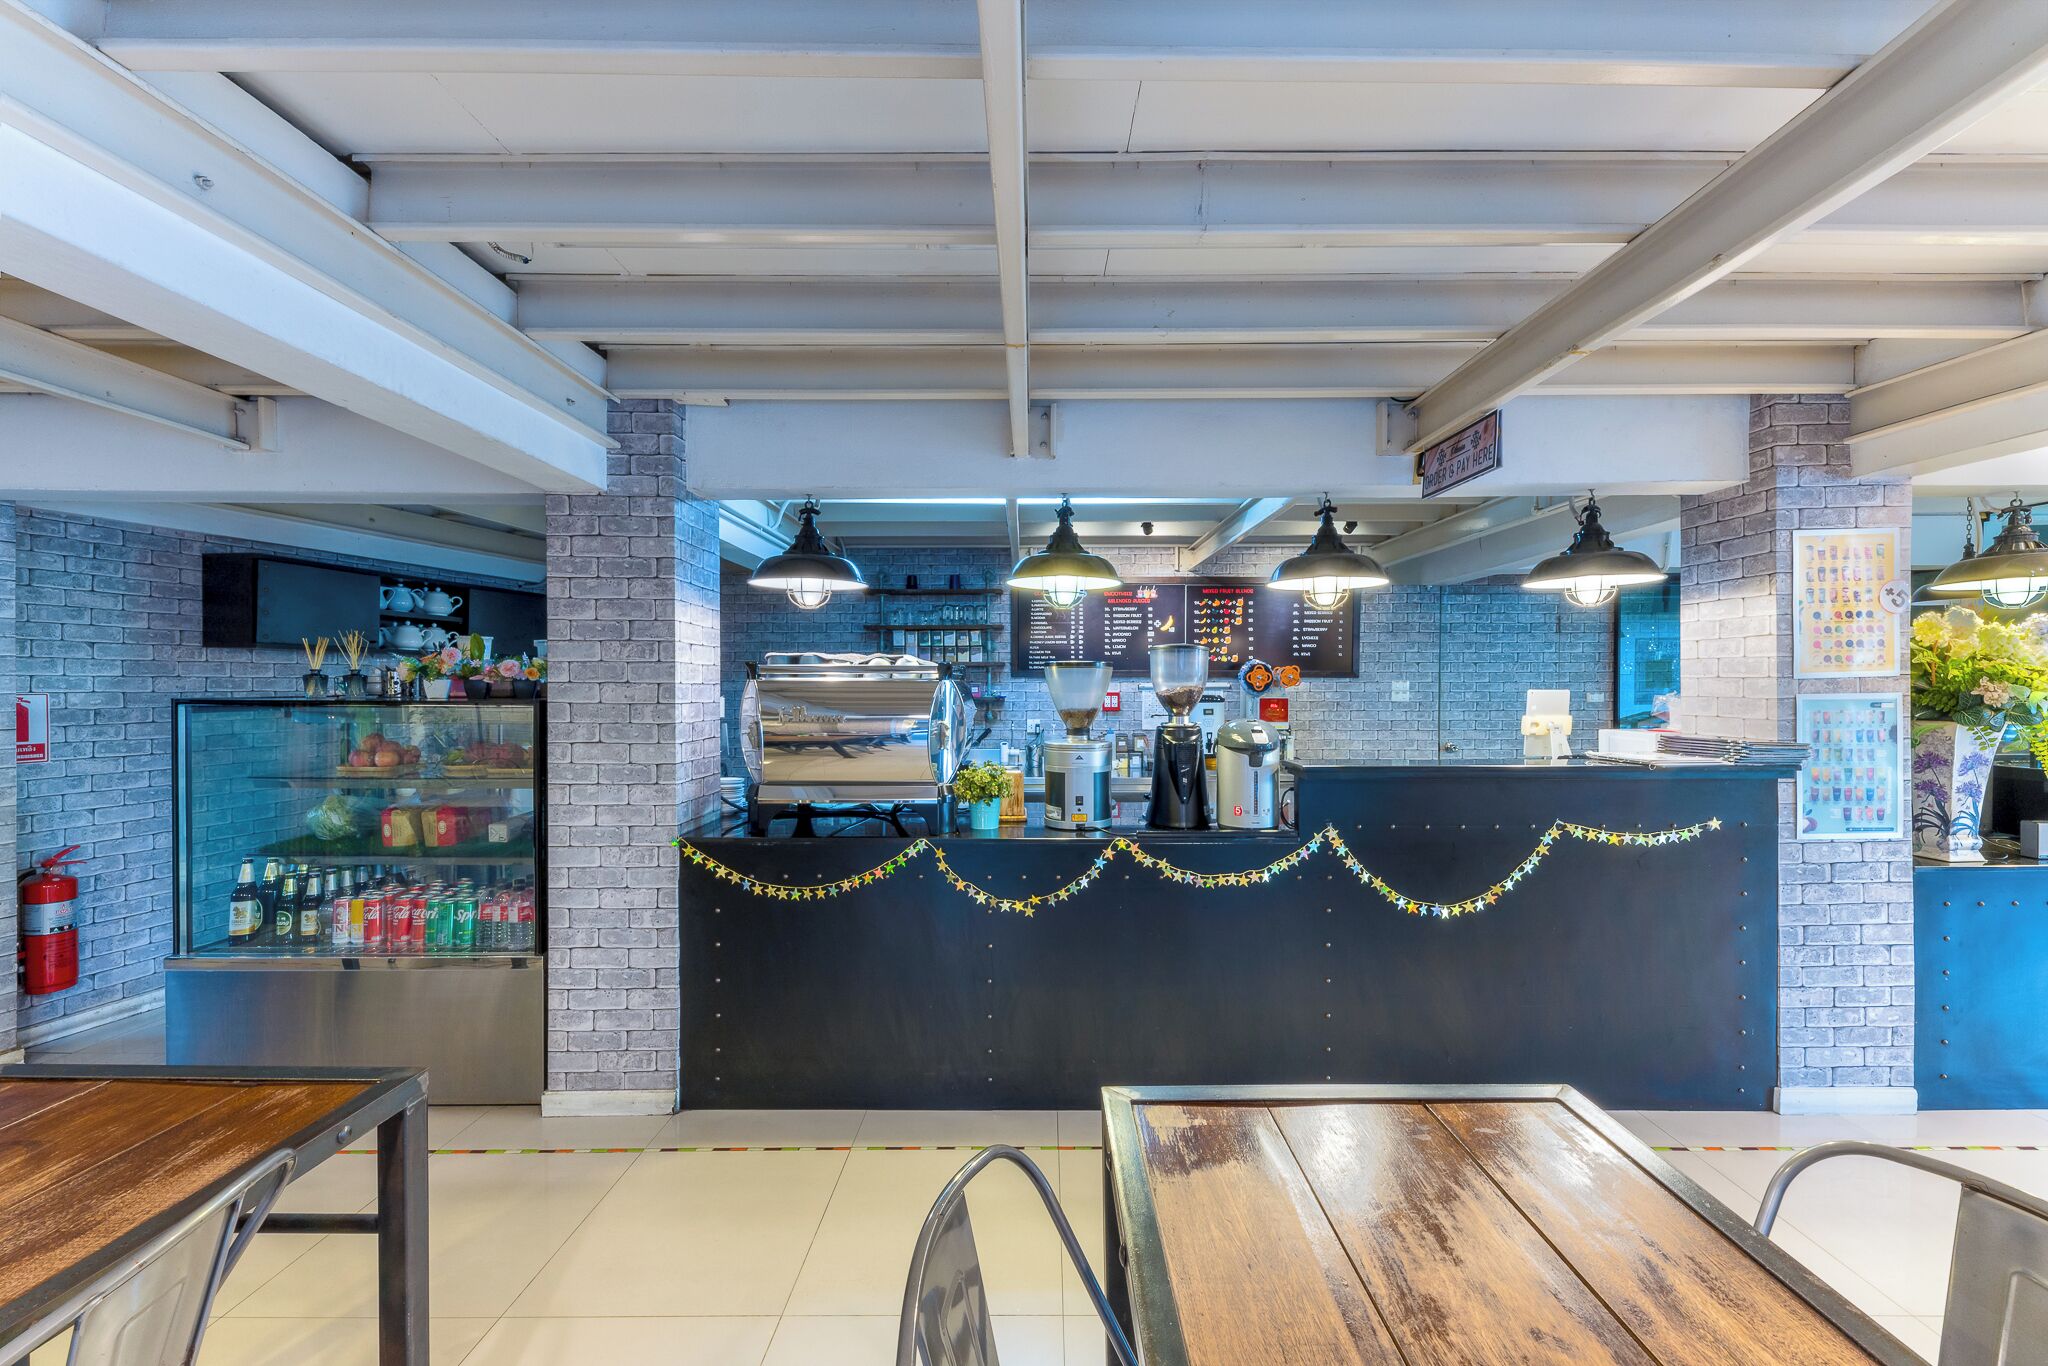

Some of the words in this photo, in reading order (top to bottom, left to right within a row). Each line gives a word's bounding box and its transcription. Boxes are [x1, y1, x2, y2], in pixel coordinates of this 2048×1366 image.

[1425, 468, 1447, 490] ORDER
[1449, 464, 1455, 478] &
[1456, 458, 1471, 475] PAY
[1472, 444, 1494, 469] HERE
